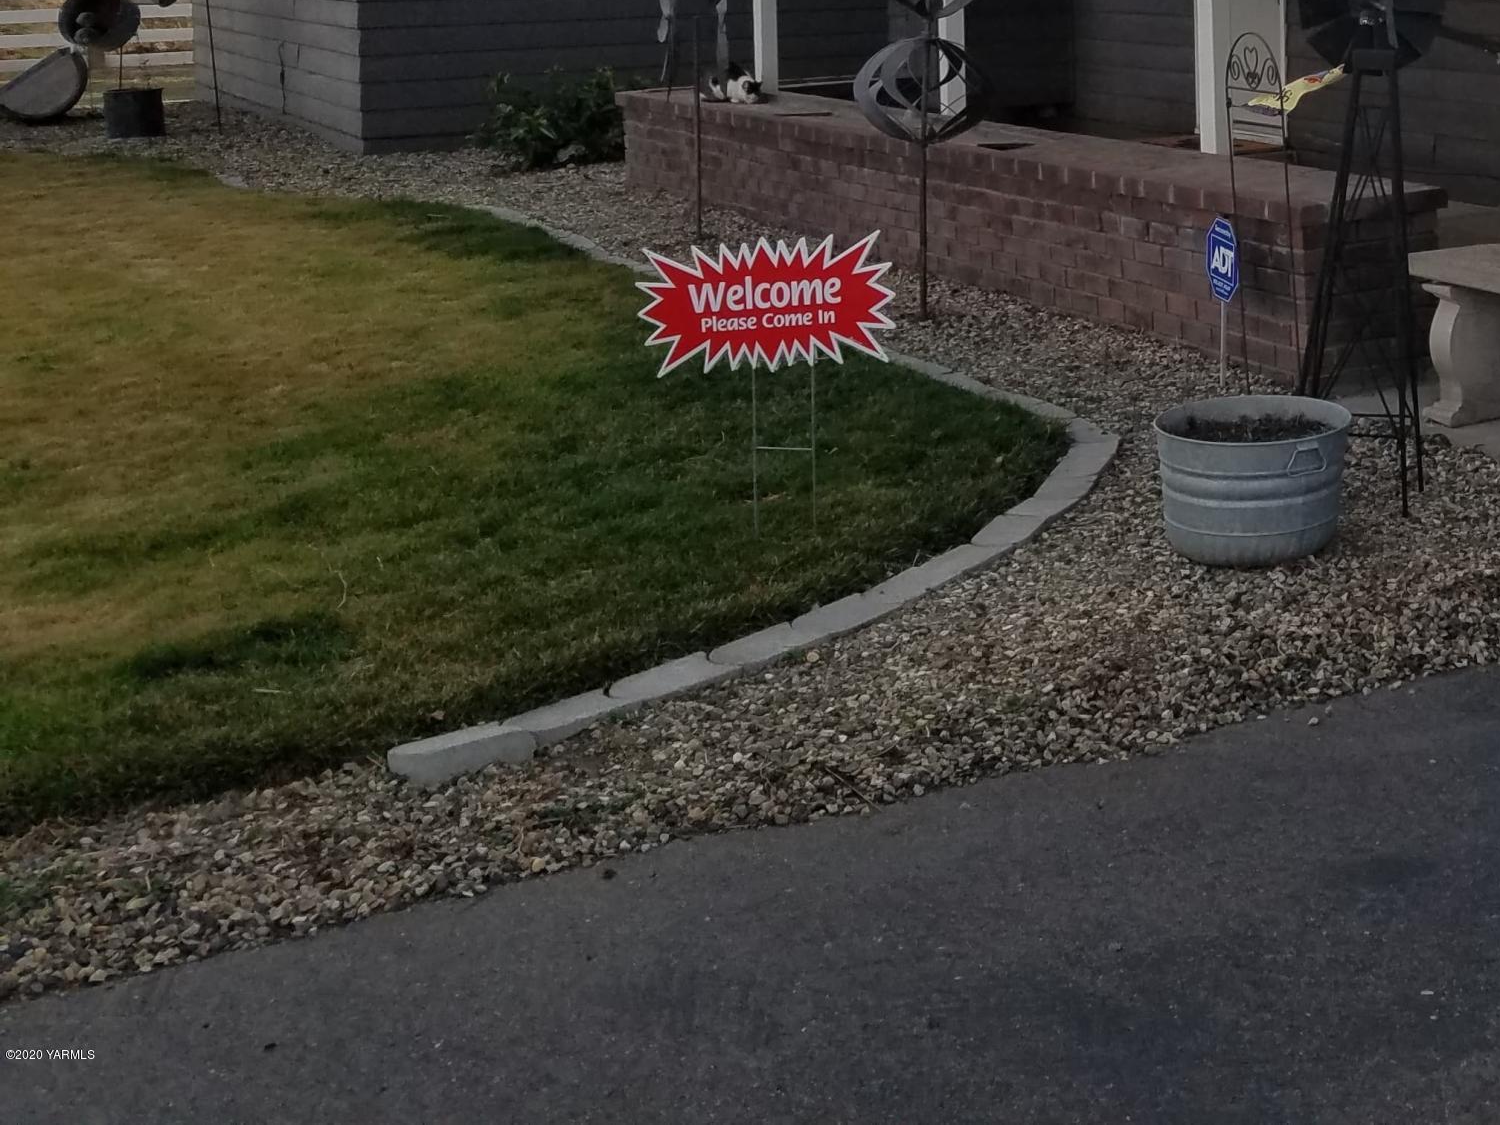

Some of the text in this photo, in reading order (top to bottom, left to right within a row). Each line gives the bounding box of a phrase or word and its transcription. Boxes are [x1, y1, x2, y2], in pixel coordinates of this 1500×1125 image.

[1211, 246, 1234, 277] ADT
[688, 276, 842, 314] Welcome
[701, 309, 836, 333] Please Come In
